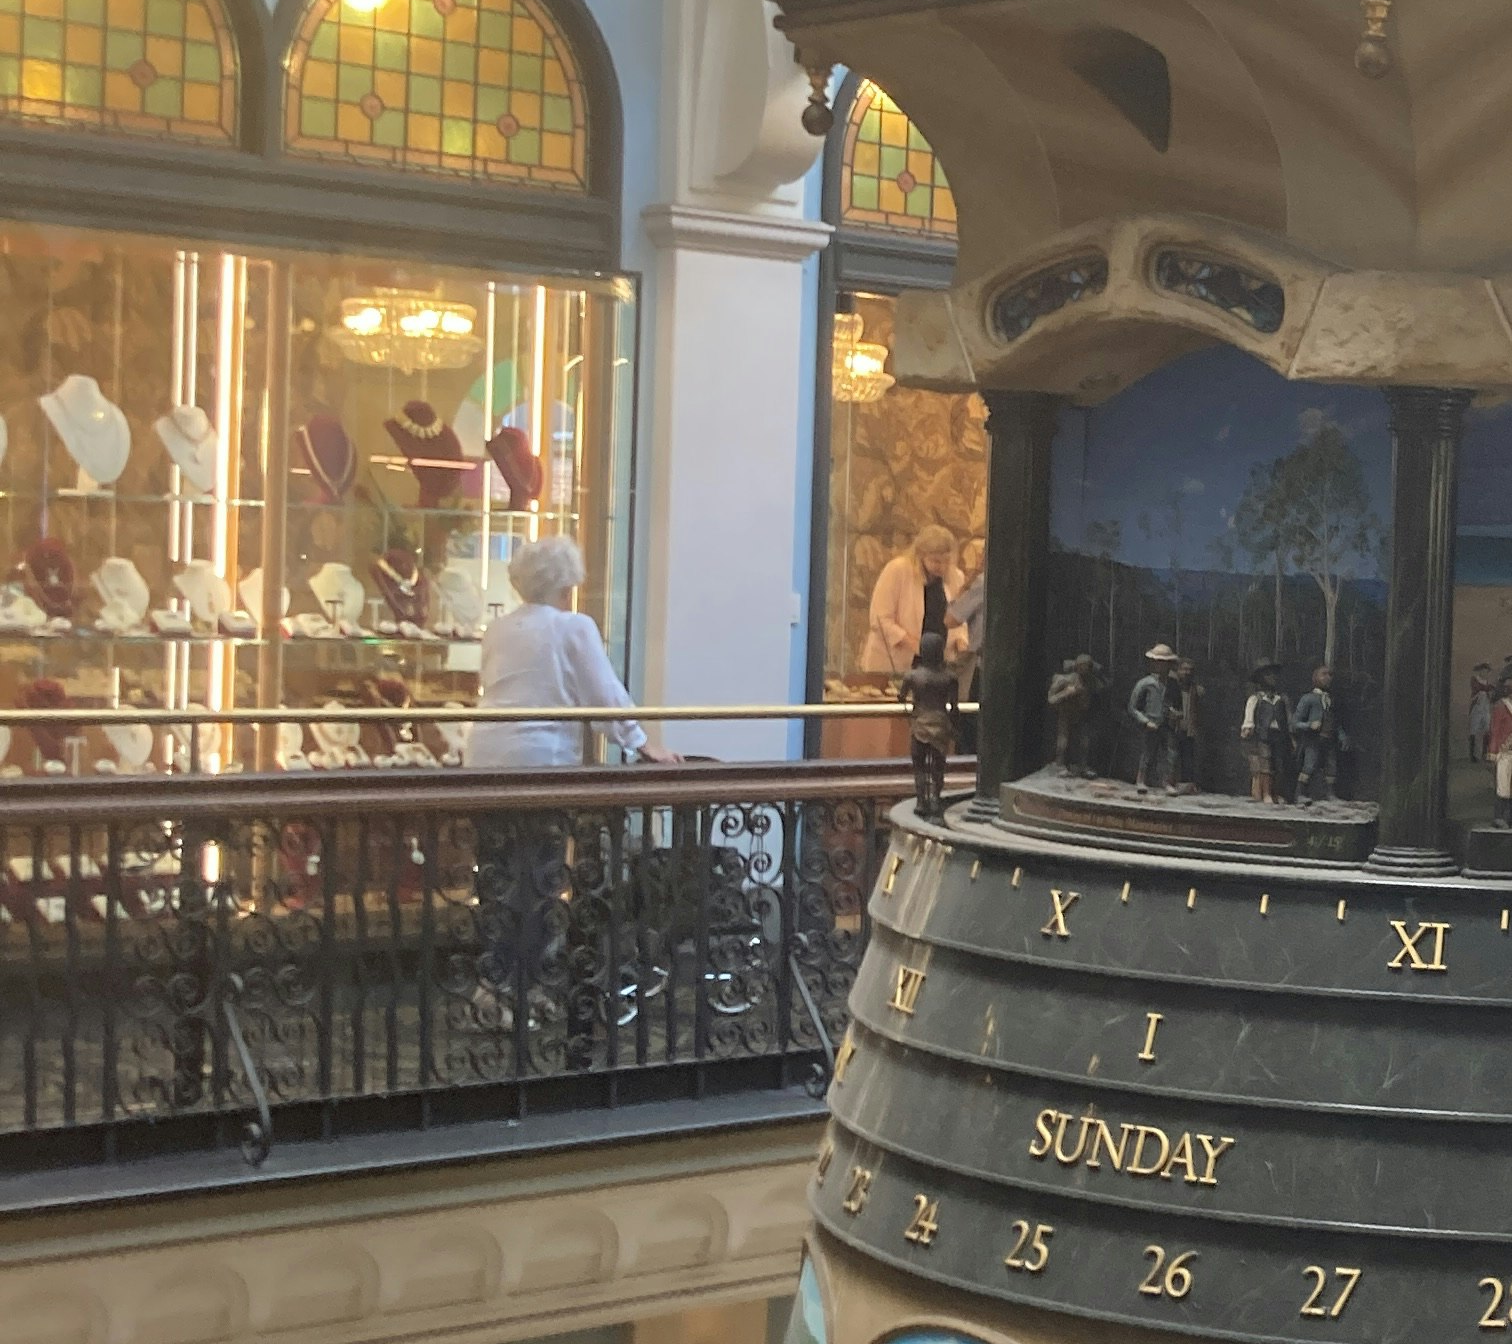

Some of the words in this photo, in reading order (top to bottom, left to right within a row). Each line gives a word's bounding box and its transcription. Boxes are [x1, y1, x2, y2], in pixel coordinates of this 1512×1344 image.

[1041, 889, 1080, 937] X
[1386, 920, 1451, 971] XI
[1138, 1012, 1164, 1061] I
[1028, 1107, 1235, 1185] SUNDAY
[903, 1194, 940, 1245] 24
[1005, 1220, 1055, 1273] 25
[1138, 1245, 1199, 1299] 26
[1300, 1266, 1363, 1317] 27
